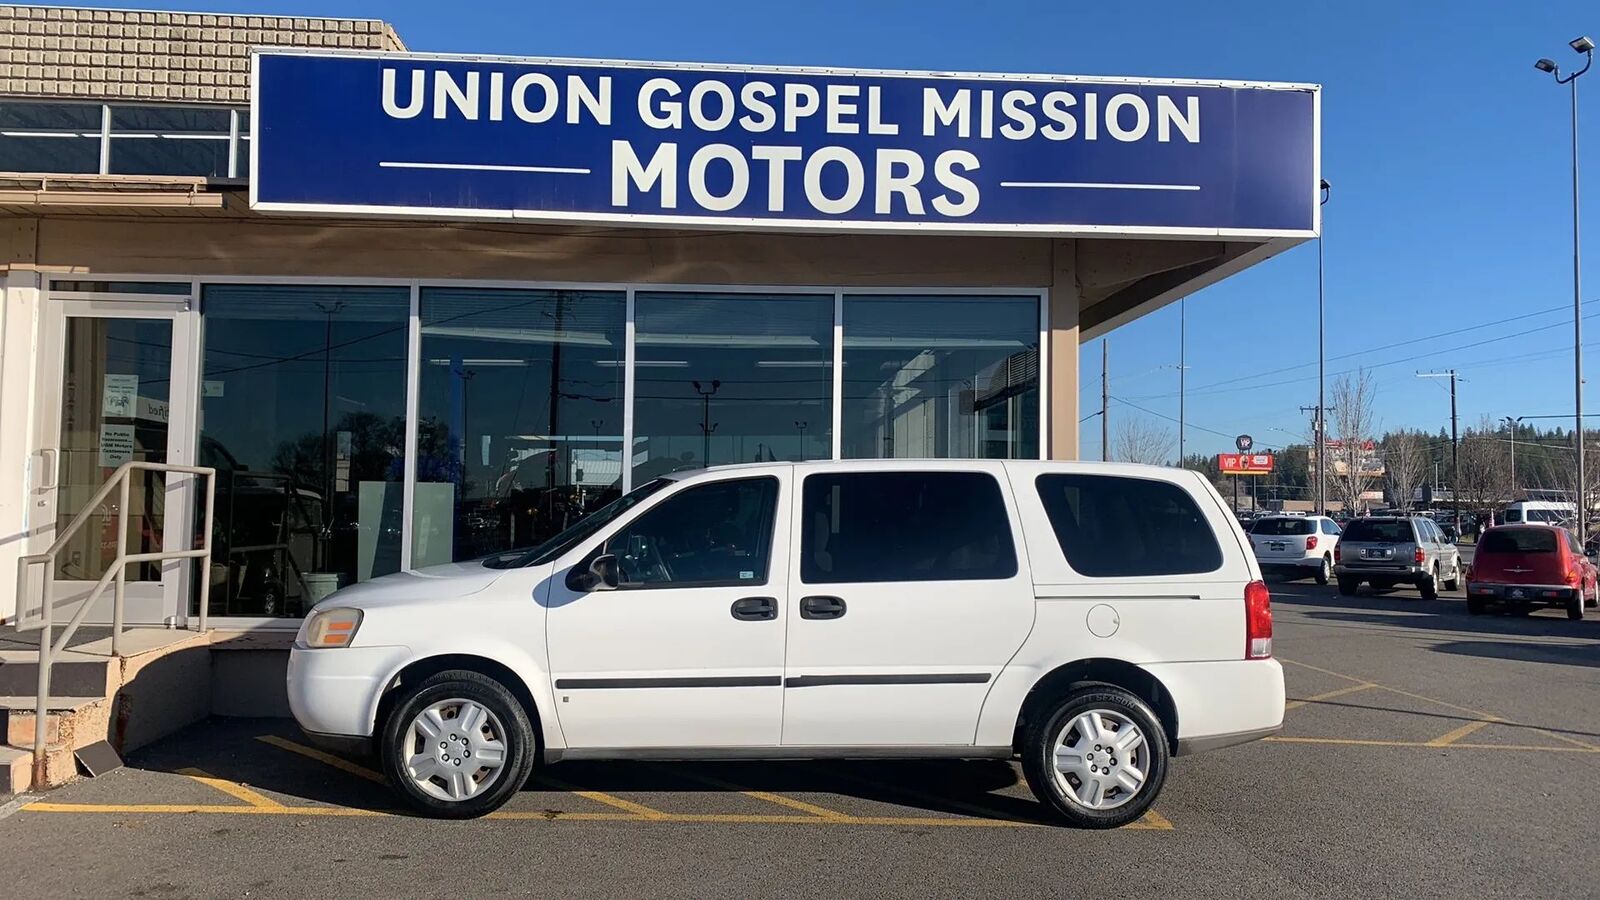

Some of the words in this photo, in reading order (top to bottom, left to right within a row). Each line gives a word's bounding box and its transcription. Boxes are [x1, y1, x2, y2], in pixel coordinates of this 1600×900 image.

[381, 68, 612, 126] UNION
[637, 77, 899, 135] GOSPEL
[922, 87, 1201, 143] MISSION
[611, 139, 981, 217] MOTORS
[1223, 457, 1237, 468] VIP
[1096, 695, 1136, 708] SEASON
